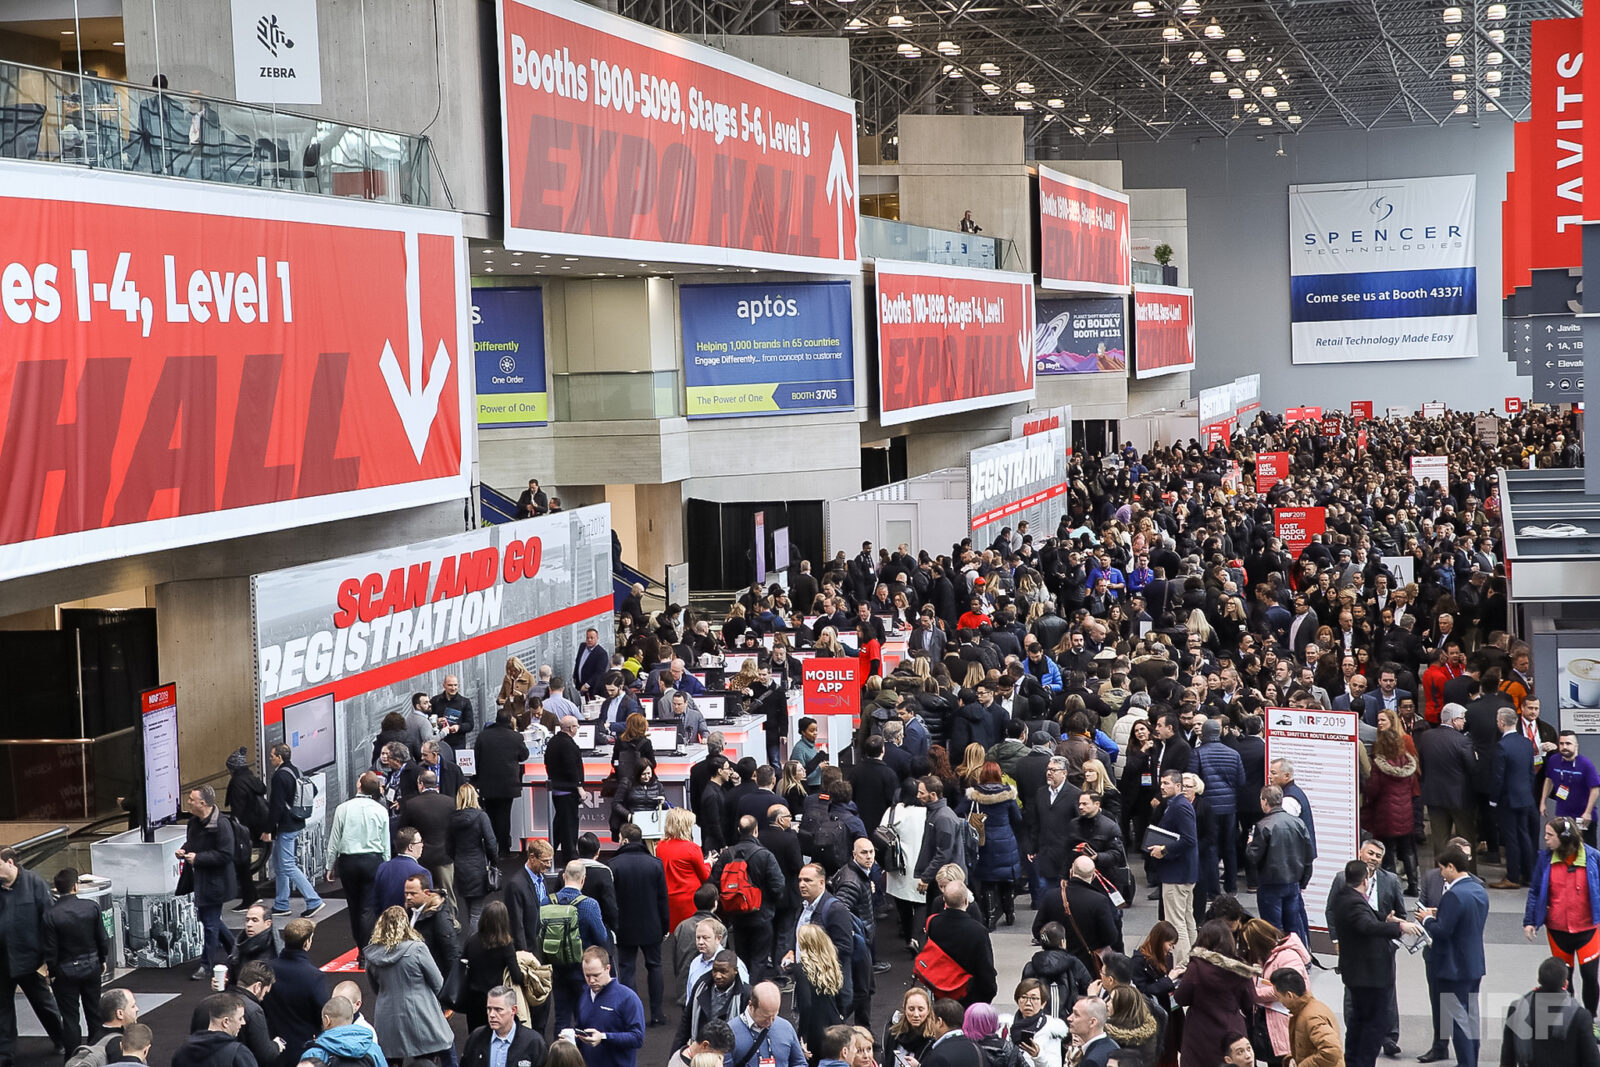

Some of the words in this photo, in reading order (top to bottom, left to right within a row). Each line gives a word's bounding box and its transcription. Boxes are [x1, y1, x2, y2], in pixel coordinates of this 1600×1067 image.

[260, 67, 296, 79] ZEBRA
[510, 33, 588, 103] Booths
[590, 59, 686, 135] 1900-5099,
[688, 87, 738, 145] Stages
[740, 103, 767, 154] 5-6,
[768, 111, 801, 156] Level
[801, 121, 811, 158] 3
[1557, 52, 1584, 233] JAVITS
[518, 114, 697, 245] EXPO
[708, 154, 821, 258] HALL
[1304, 225, 1462, 245] SPENCER
[1305, 241, 1462, 255] TECHNOLOGIES
[71, 249, 153, 338] 1-4,
[163, 254, 270, 324] Level
[276, 260, 293, 323] 1
[1306, 293, 1338, 303] Come
[1341, 293, 1360, 302] see
[1363, 293, 1376, 301] us
[1378, 291, 1390, 300] at
[1393, 288, 1427, 299] Booth
[1430, 287, 1462, 298] 4337!
[881, 292, 911, 324] Booths
[948, 295, 972, 330] Stages
[984, 297, 1000, 324] Level
[1073, 319, 1086, 329] GO
[1087, 318, 1120, 329] BOLDLY
[1557, 324, 1581, 332] Javits
[1073, 330, 1099, 338] BOOTH
[1100, 329, 1121, 338] #1131
[1315, 337, 1343, 346] Retail
[1345, 335, 1400, 346] Technology
[1402, 334, 1429, 343] Made
[1431, 333, 1454, 343] Easy
[696, 341, 727, 353] Helping
[730, 339, 751, 352] 1,000
[754, 338, 781, 349] brands
[783, 338, 790, 348] in
[792, 338, 802, 348] 65
[804, 337, 840, 347] countries
[1573, 342, 1584, 350] 1B
[695, 357, 720, 367] Engage
[762, 354, 777, 363] from
[779, 353, 804, 364] concept
[813, 352, 842, 360] customer
[492, 376, 505, 384] One
[506, 375, 524, 384] Order
[885, 334, 958, 411] EXPO
[697, 396, 711, 405] The
[714, 395, 736, 404] Power
[739, 394, 746, 403] of
[748, 394, 763, 402] One
[791, 391, 815, 400] BOOTH
[815, 389, 837, 400] 3705
[480, 404, 506, 413] Power
[508, 404, 517, 412] of
[519, 403, 536, 412] One
[0, 353, 361, 546] HALL
[334, 561, 431, 629] SCAN
[431, 547, 499, 604] AND
[503, 536, 542, 583] GO
[260, 585, 504, 697] REGISTRATION
[805, 670, 854, 681] MOBILE
[817, 682, 843, 693] APP
[578, 791, 605, 808] RF
